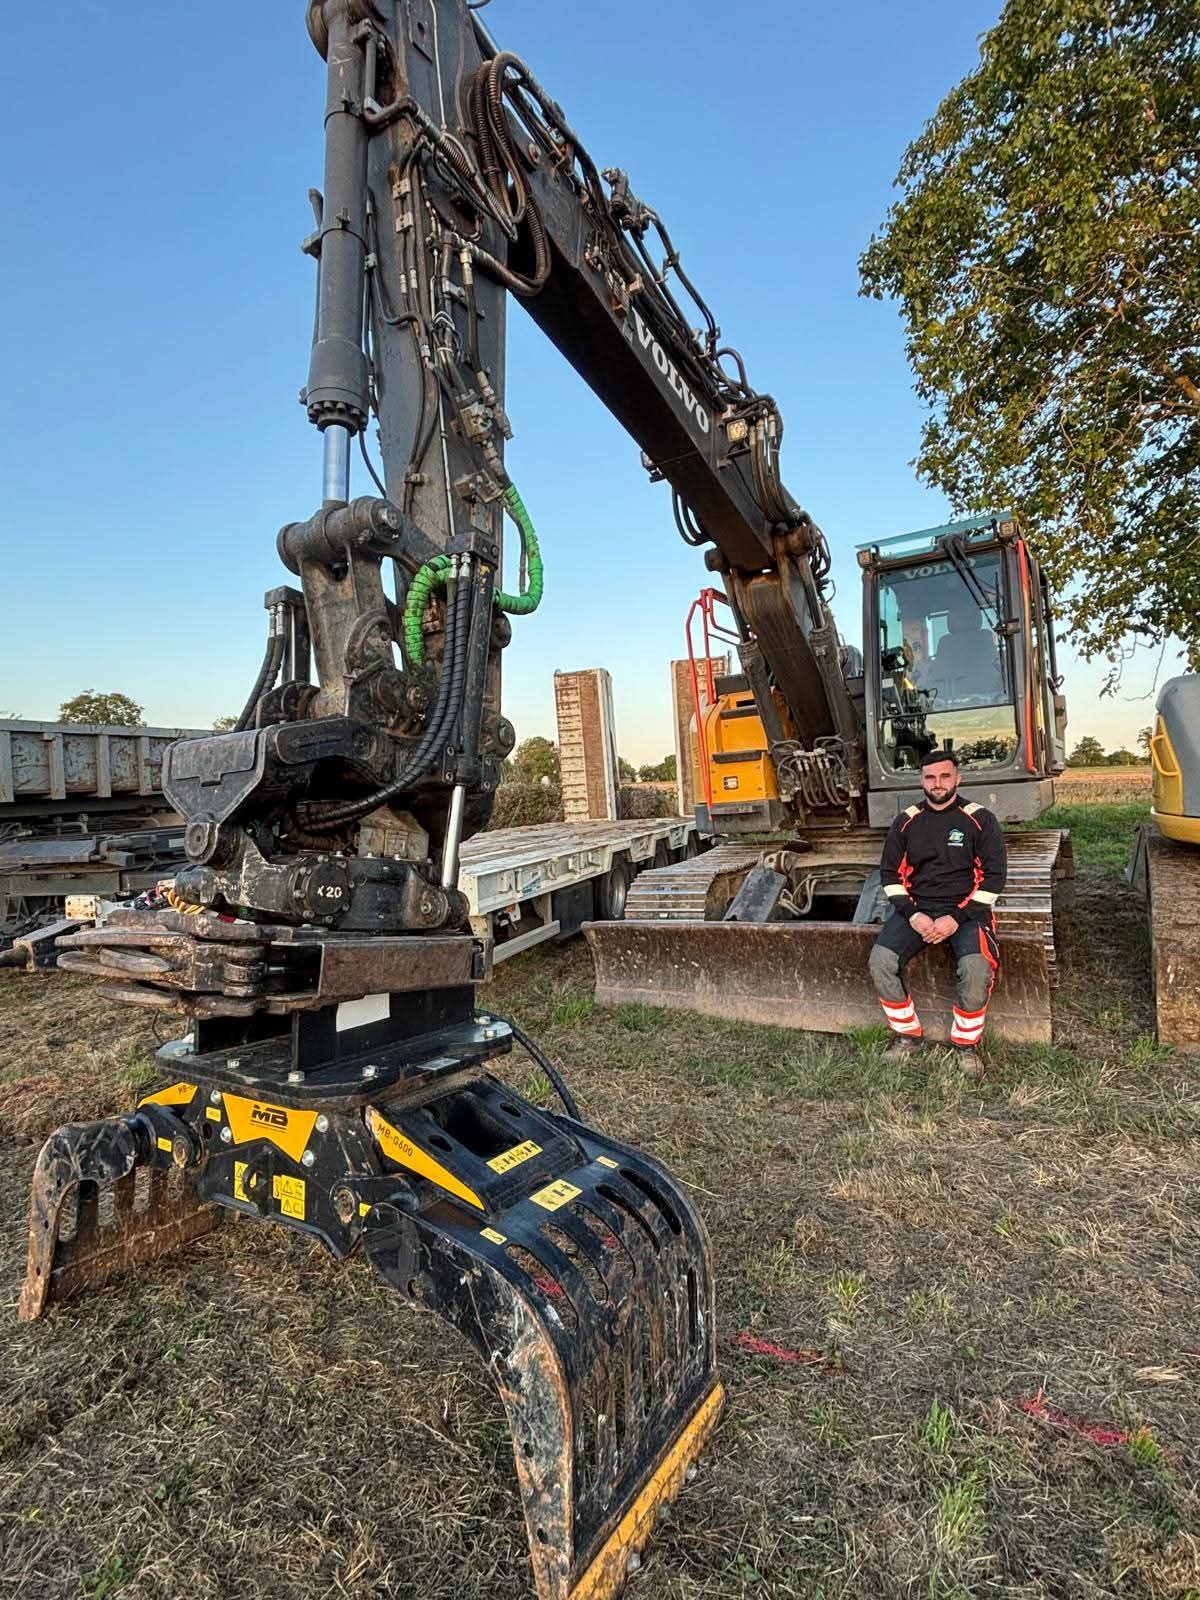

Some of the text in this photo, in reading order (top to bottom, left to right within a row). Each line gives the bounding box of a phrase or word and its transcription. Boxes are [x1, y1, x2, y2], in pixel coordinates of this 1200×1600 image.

[631, 306, 710, 433] VOLVO
[251, 1104, 289, 1127] MB
[377, 1122, 414, 1157] MB-G600
